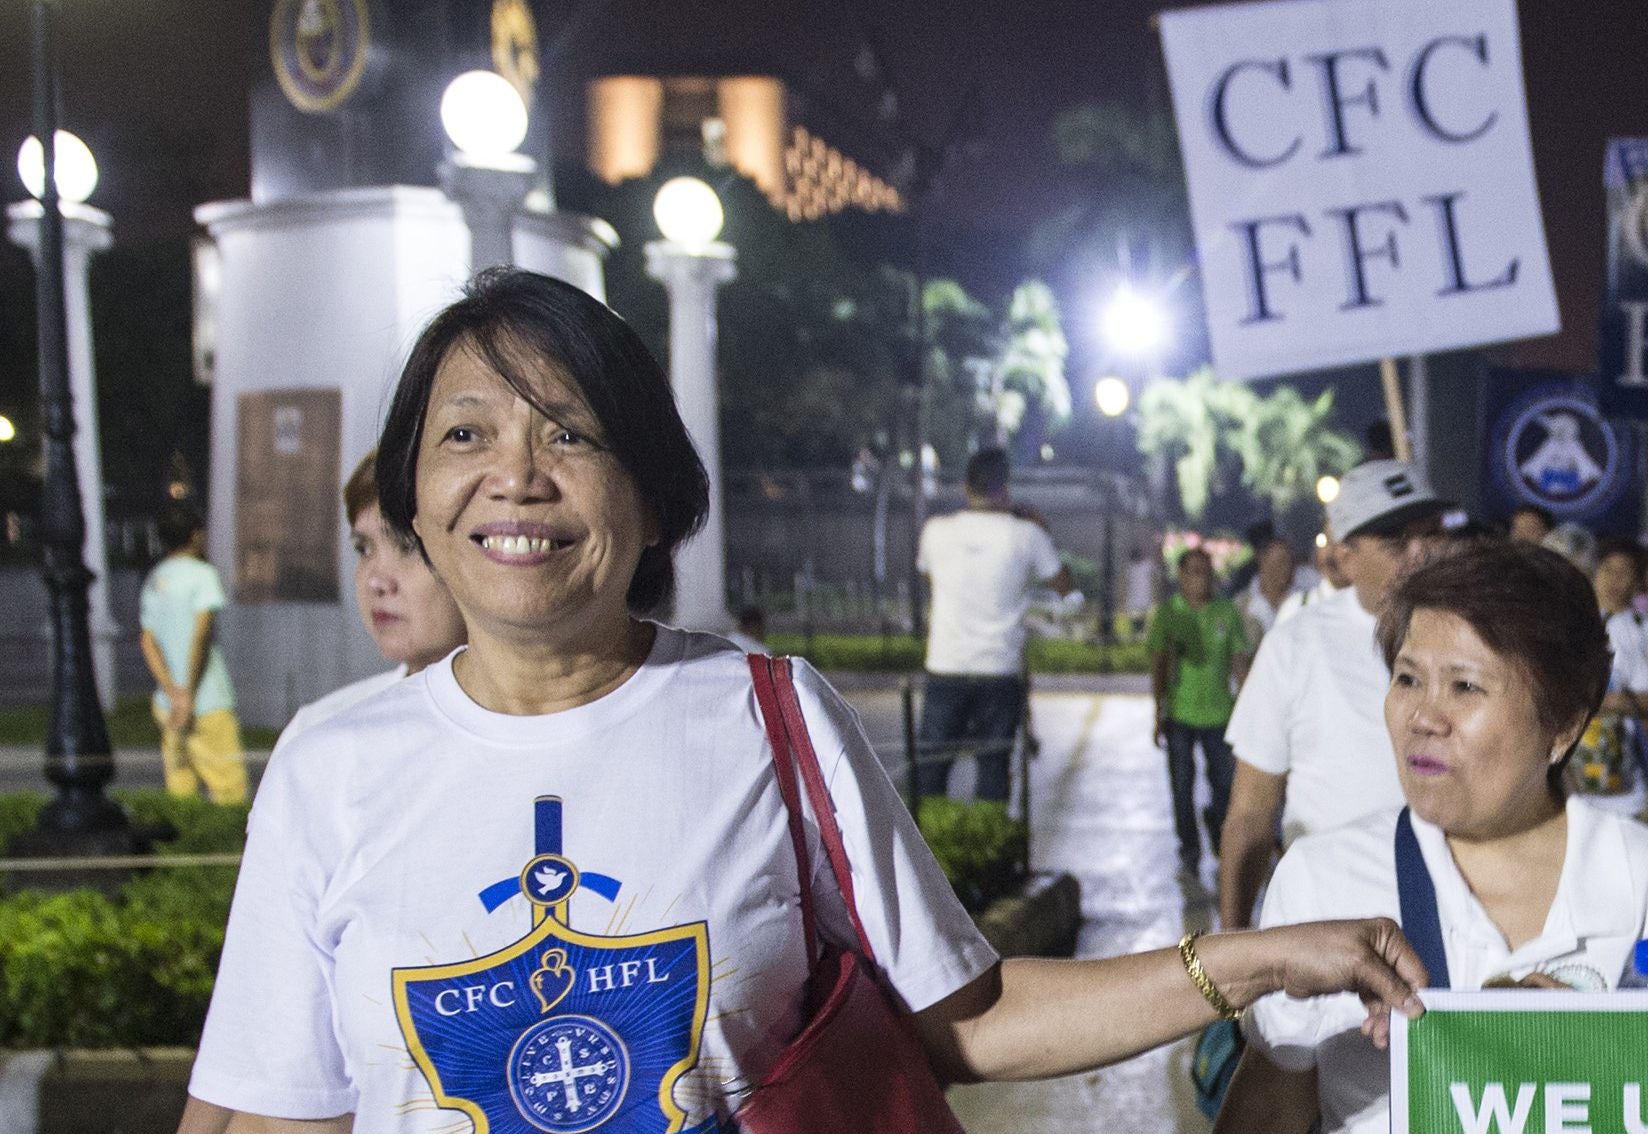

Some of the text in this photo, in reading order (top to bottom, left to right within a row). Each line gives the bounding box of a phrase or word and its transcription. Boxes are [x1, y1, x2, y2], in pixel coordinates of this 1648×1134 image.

[1203, 32, 1498, 170] CFC
[1228, 191, 1521, 327] FFL
[434, 980, 517, 1017] CFC
[587, 957, 670, 994] HFL
